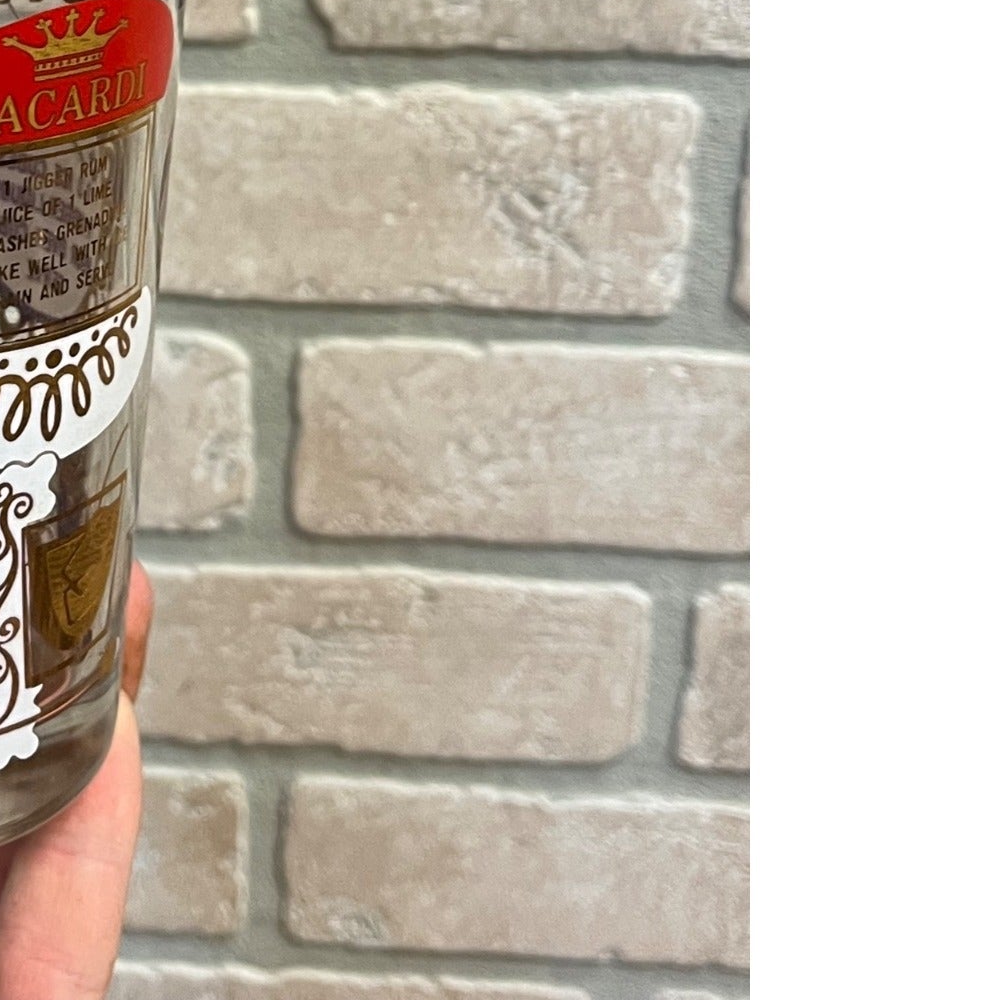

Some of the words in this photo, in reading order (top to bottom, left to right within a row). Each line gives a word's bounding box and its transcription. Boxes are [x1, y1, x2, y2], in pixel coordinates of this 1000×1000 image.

[21, 167, 74, 194] JIGGER
[80, 156, 108, 179] RUM
[42, 197, 61, 217] OF
[83, 180, 113, 206] LIME
[28, 255, 67, 277] WELL
[73, 236, 108, 261] WITH
[40, 278, 69, 301] AND
[76, 264, 114, 289] SERV
